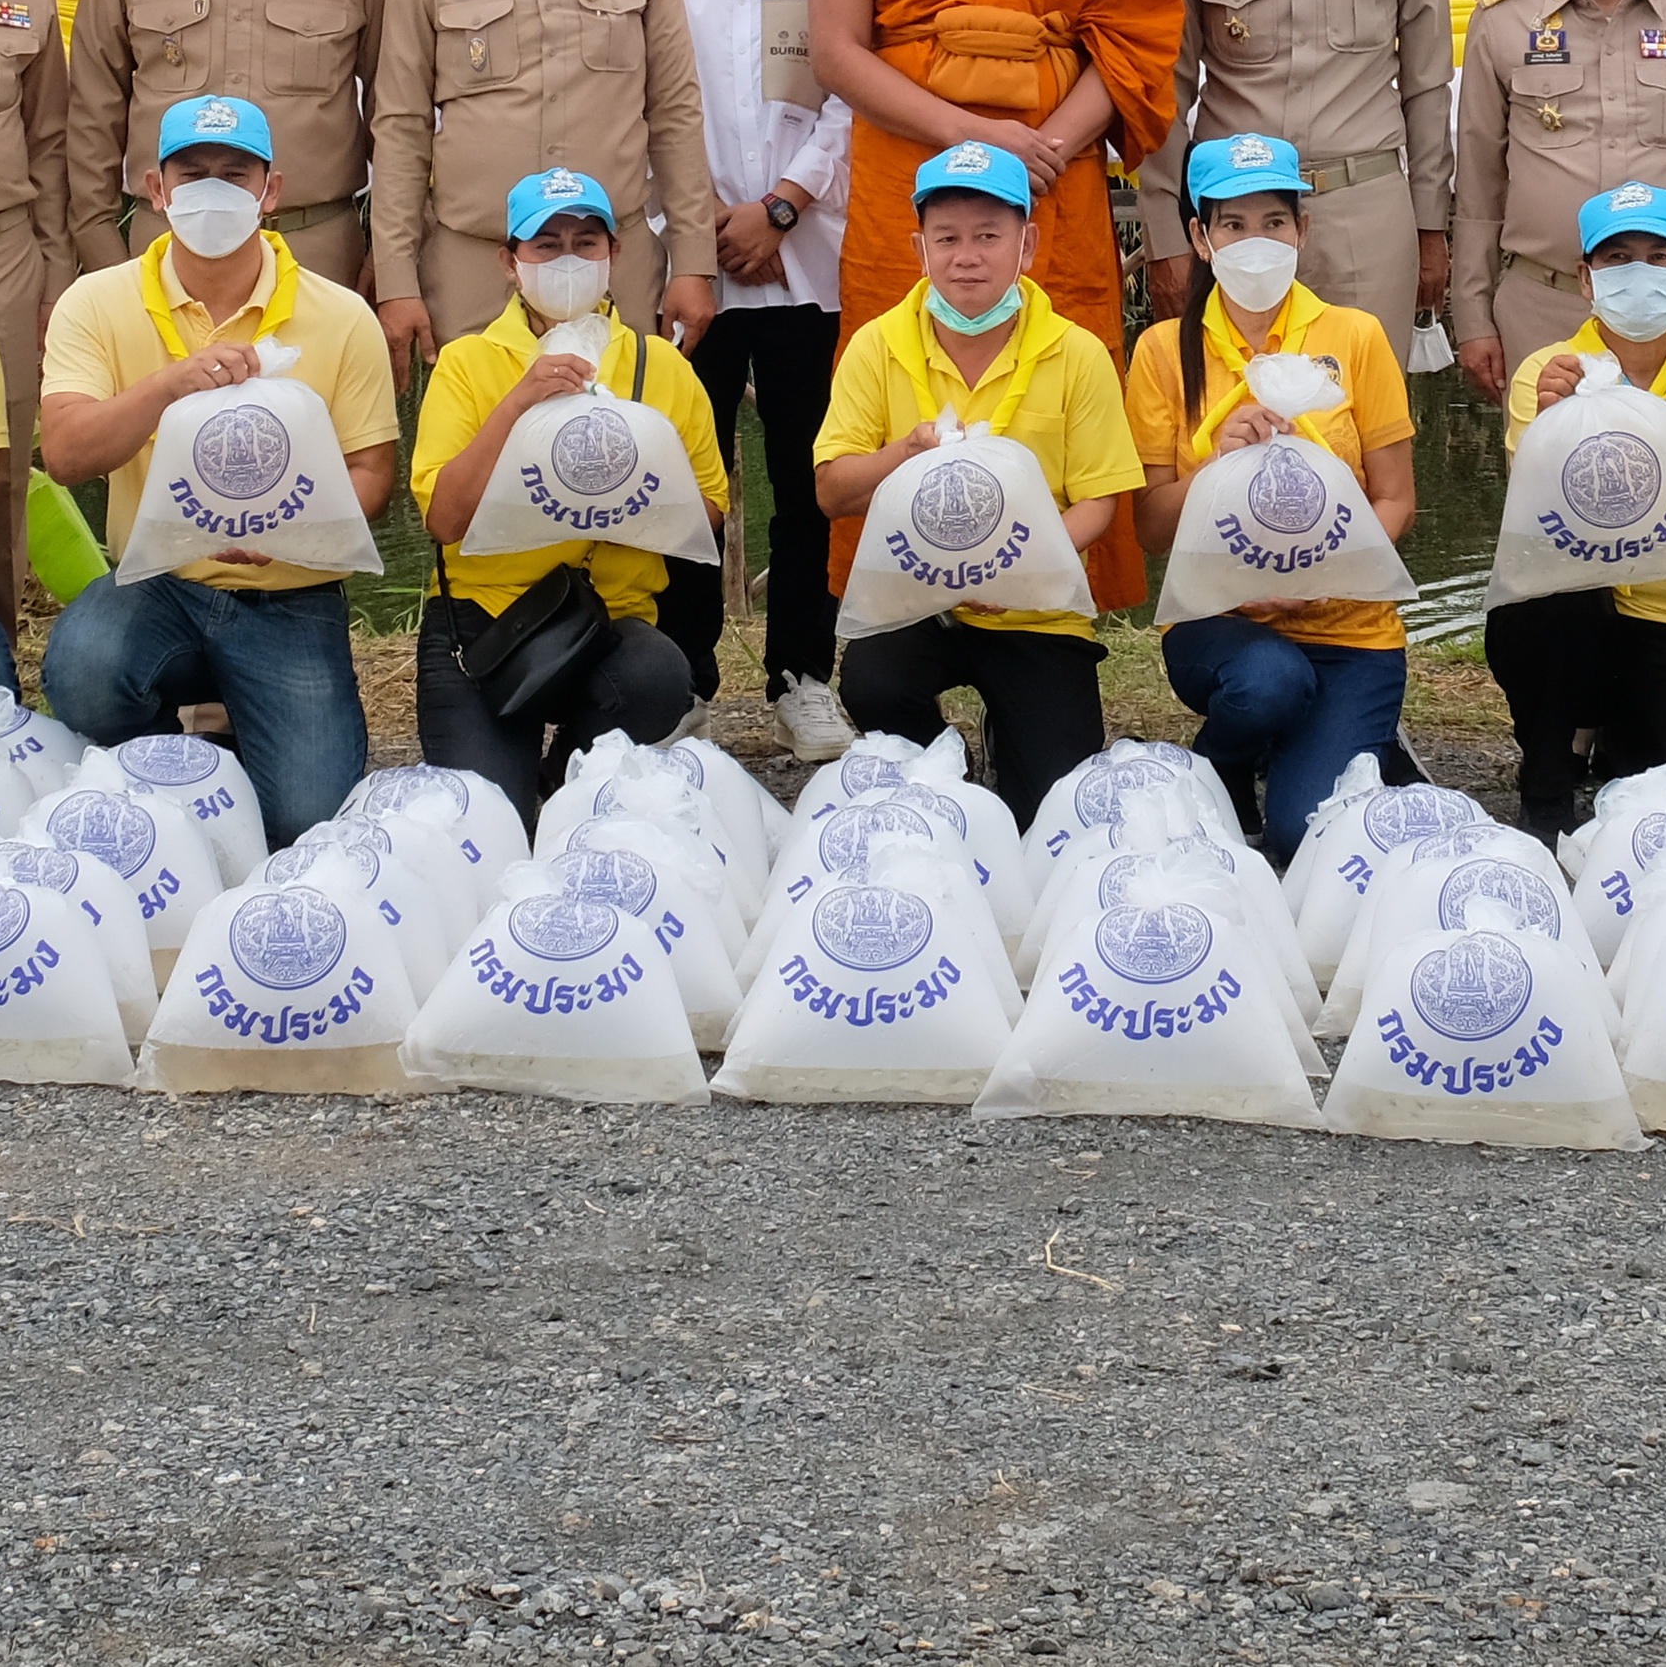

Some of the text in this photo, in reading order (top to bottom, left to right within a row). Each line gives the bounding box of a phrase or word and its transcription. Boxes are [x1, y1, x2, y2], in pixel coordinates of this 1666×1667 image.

[770, 46, 810, 57] BURBE
[168, 473, 315, 537] กรมประมง
[521, 463, 661, 531] กรมประมง
[885, 521, 1031, 589] กรมประมง
[1215, 502, 1353, 573] กรมประมง
[192, 962, 374, 1044] กรมประมง
[469, 938, 643, 1015] กรมประมง
[777, 952, 961, 1027] กรมประมง
[1056, 960, 1241, 1041] กรมประมง
[1374, 1007, 1563, 1096] กรมประมง
